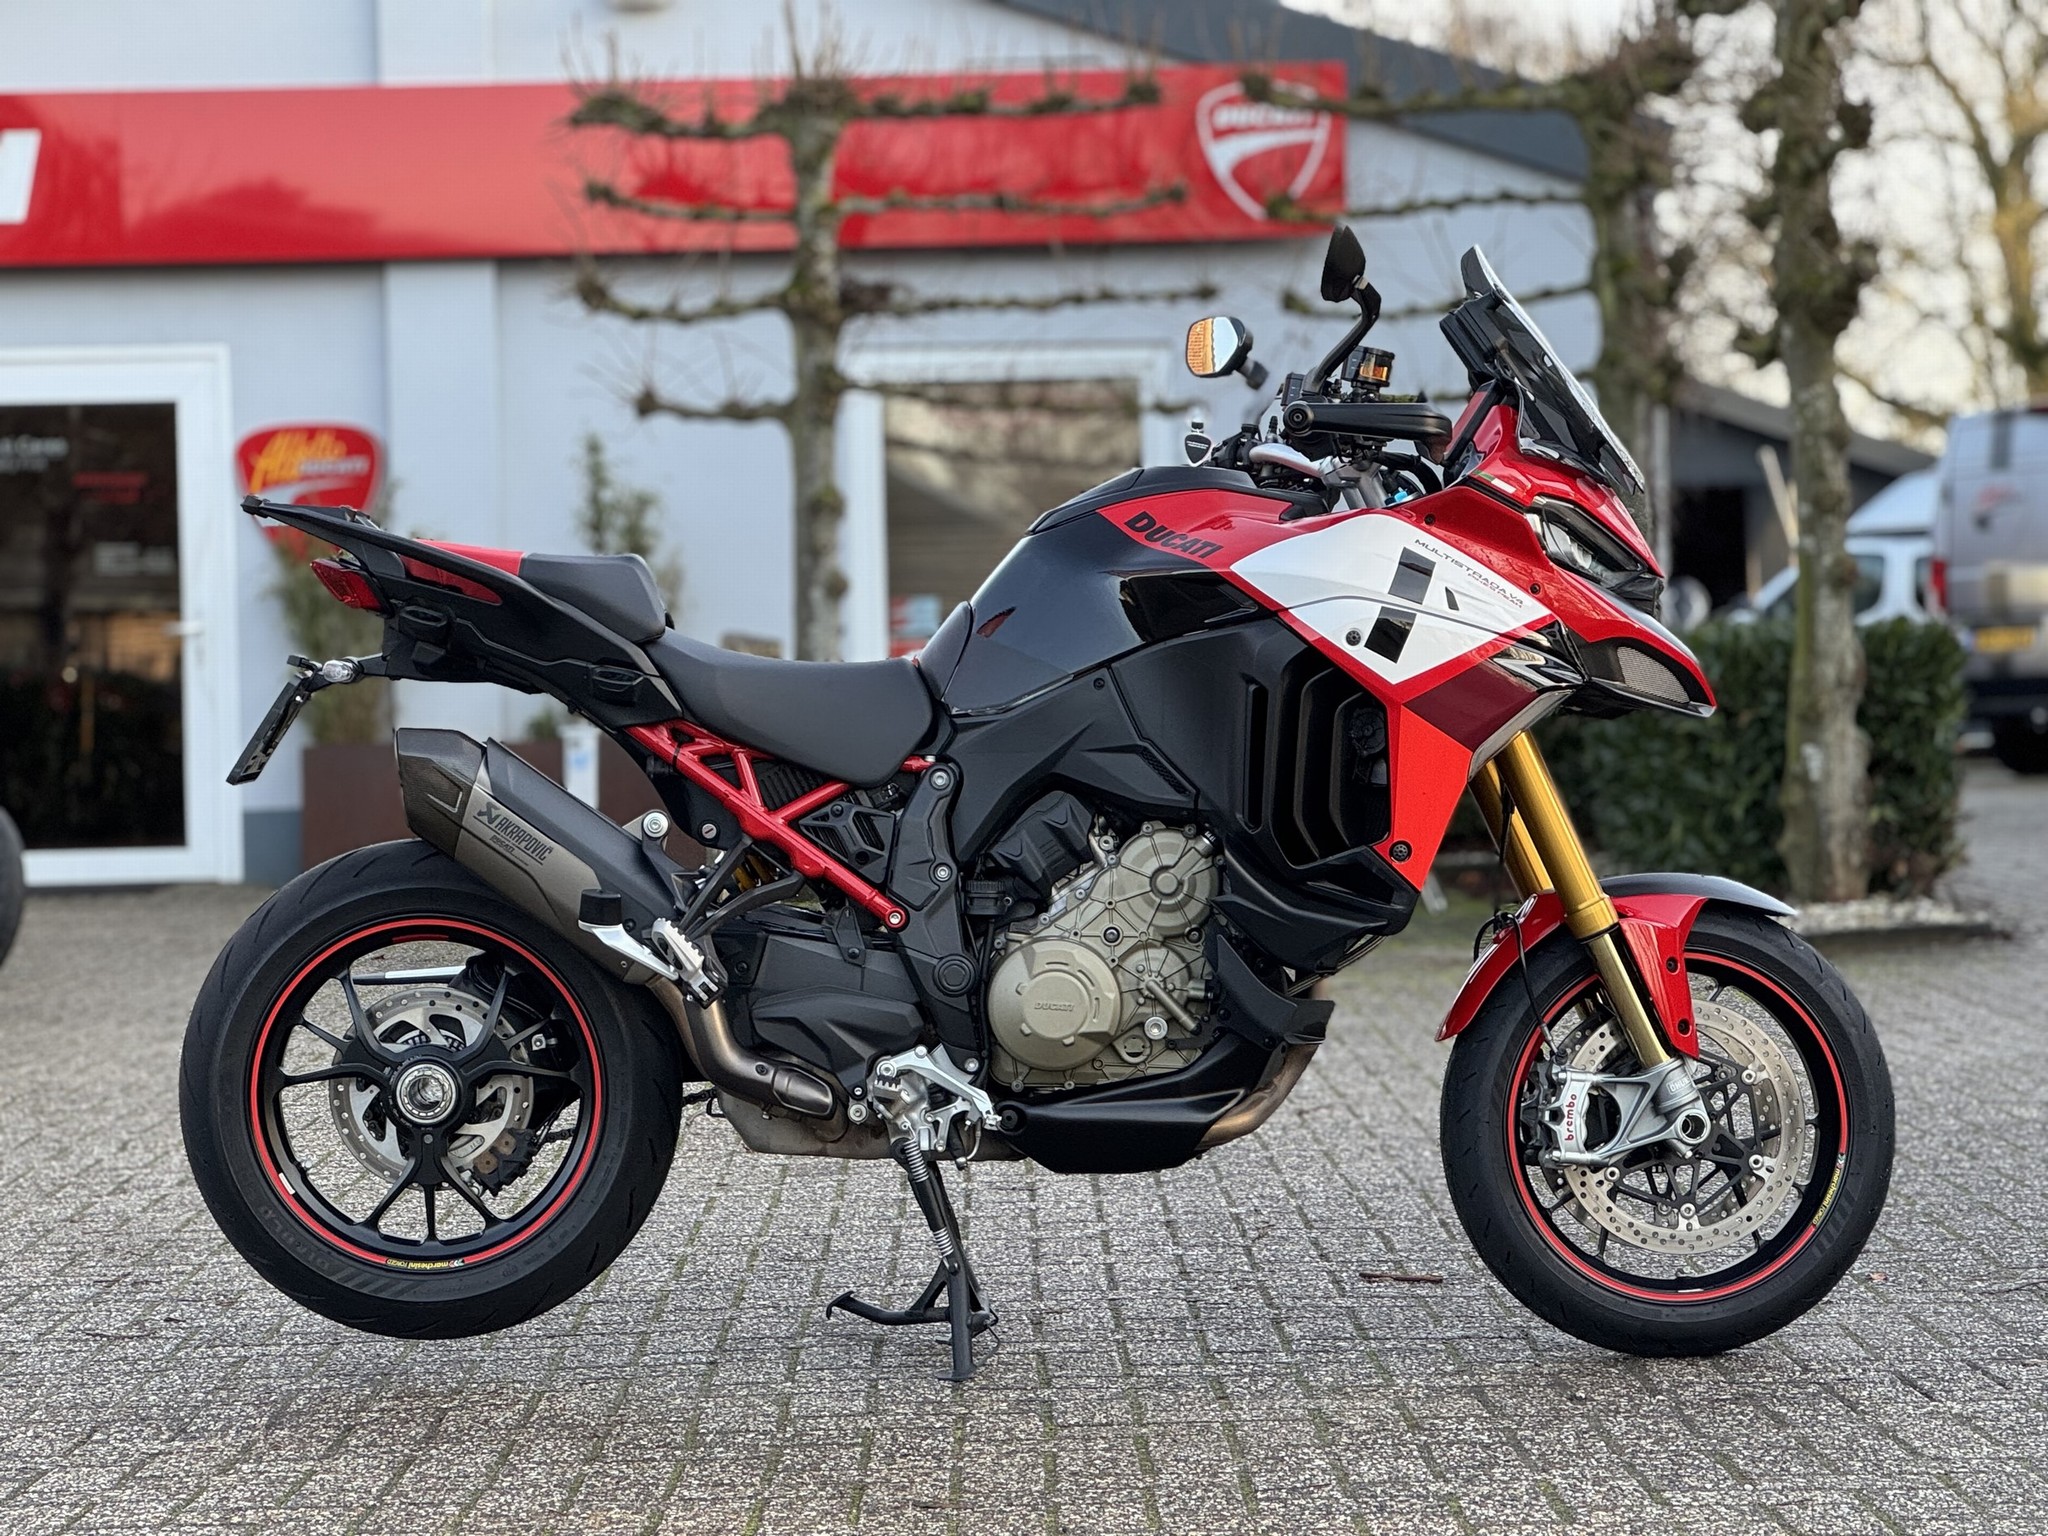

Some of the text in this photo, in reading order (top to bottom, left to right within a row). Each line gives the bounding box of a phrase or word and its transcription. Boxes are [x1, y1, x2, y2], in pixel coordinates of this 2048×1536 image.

[1123, 511, 1224, 559] DUCATI
[1415, 539, 1524, 605] MULTISTRADA V4
[1033, 1001, 1075, 1012] DUCATI
[1565, 1094, 1577, 1141] brembo
[408, 1260, 449, 1270] marchesini
